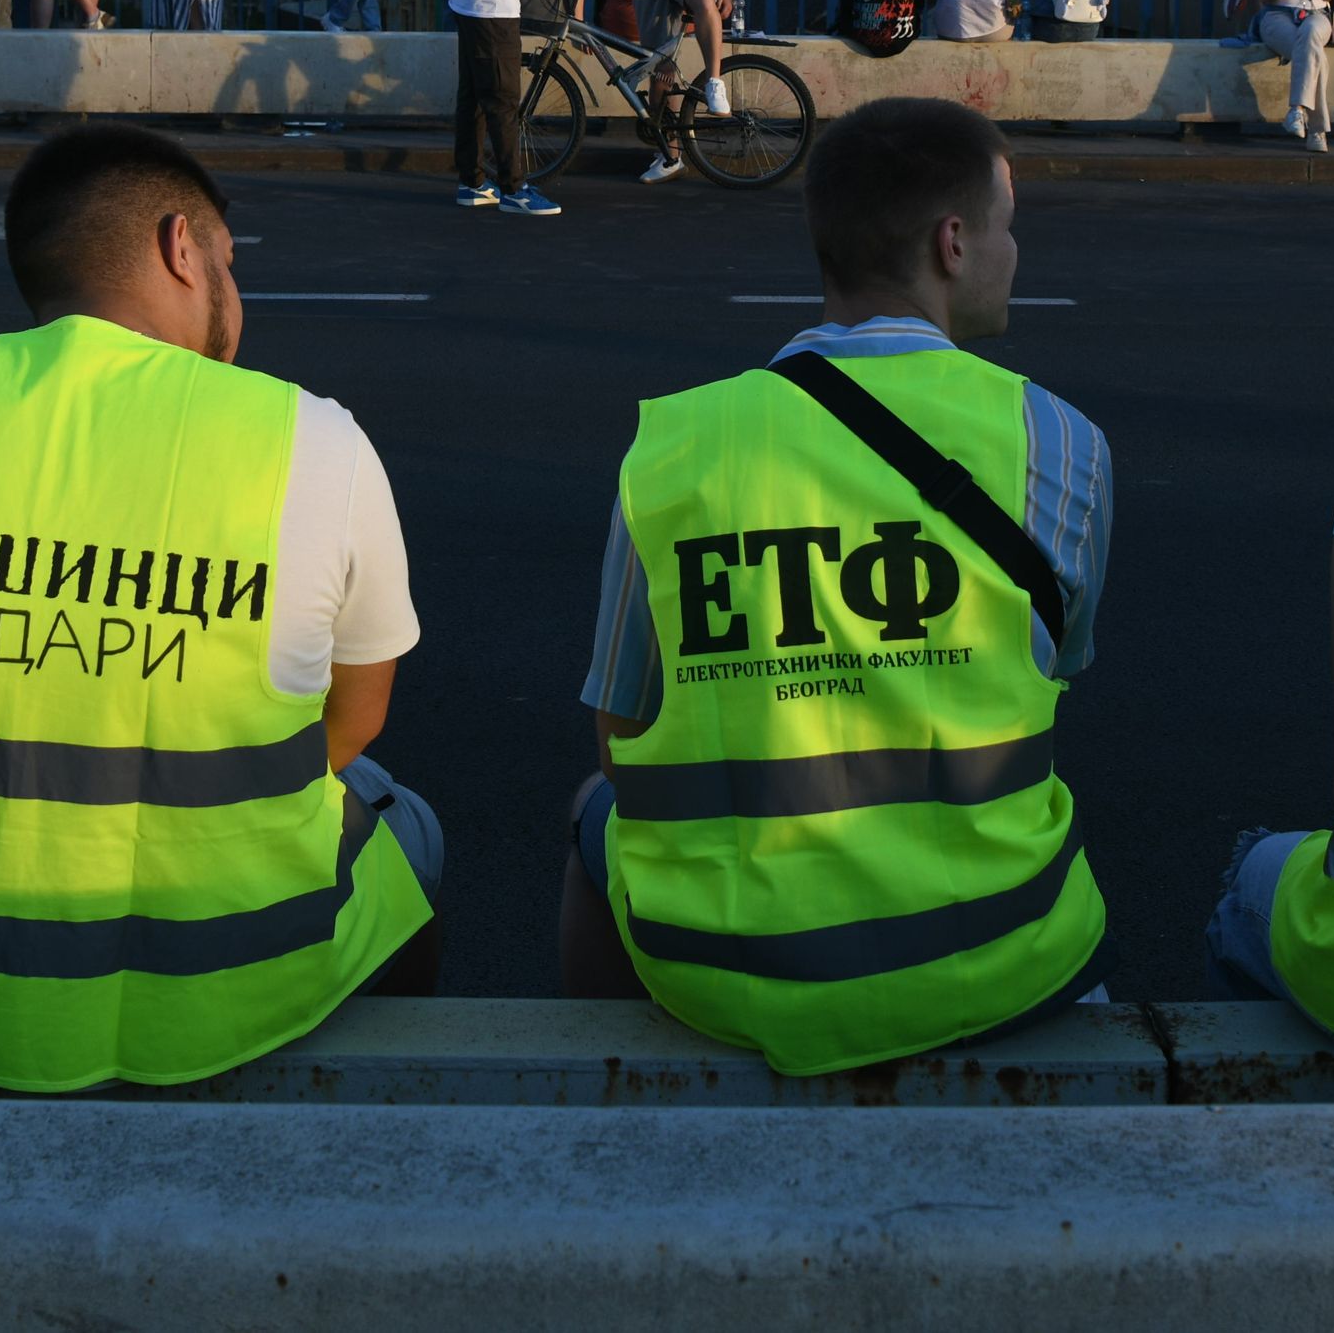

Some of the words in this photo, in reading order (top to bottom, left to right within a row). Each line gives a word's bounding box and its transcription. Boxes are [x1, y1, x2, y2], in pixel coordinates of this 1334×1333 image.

[674, 520, 960, 657] ЕТФ
[676, 653, 863, 685] ЕЛЕКТРОТЕХНИЧКИ
[867, 647, 974, 670] ФАКУЛТЕТ
[774, 676, 866, 702] БЕОГРАД
